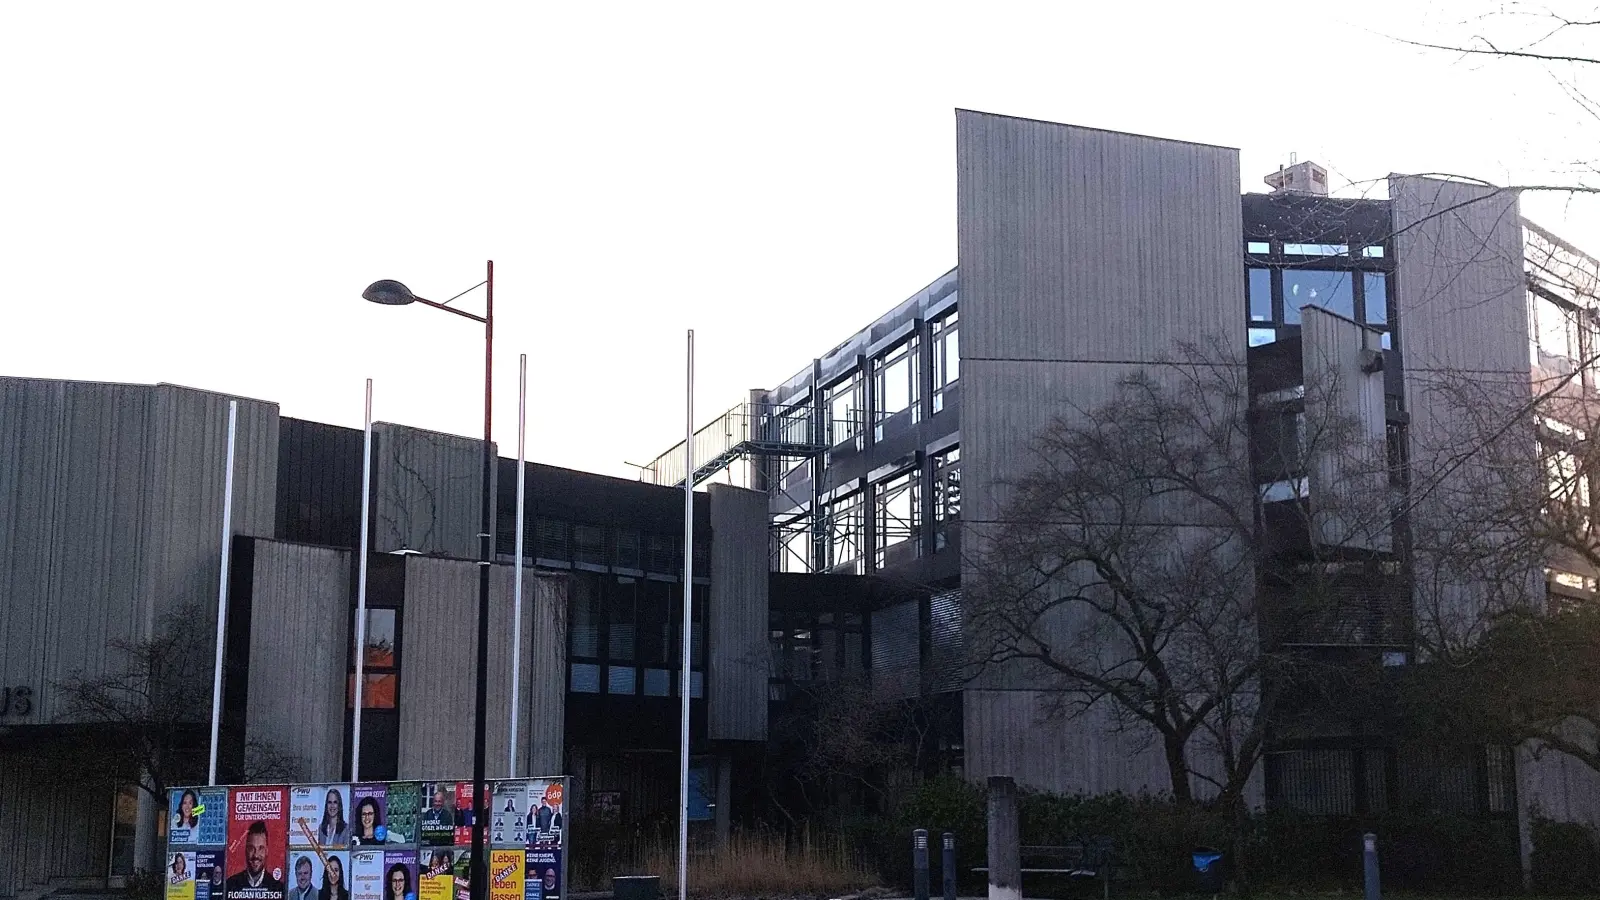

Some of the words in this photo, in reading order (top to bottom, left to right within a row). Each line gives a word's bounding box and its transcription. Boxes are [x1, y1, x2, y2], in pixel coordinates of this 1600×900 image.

[240, 792, 253, 801] MIT
[254, 792, 277, 801] IHNEN
[354, 790, 372, 798] MARION
[373, 790, 386, 798] SEITZ
[547, 791, 562, 800] ödp
[236, 803, 280, 812] GEMEINSAM
[245, 812, 281, 820] UNTERFÖHRING
[492, 853, 521, 863] Leben
[495, 864, 517, 882] DANKE
[491, 879, 517, 889] leben
[228, 891, 254, 899] FLORIAN
[491, 891, 521, 900] lassen
